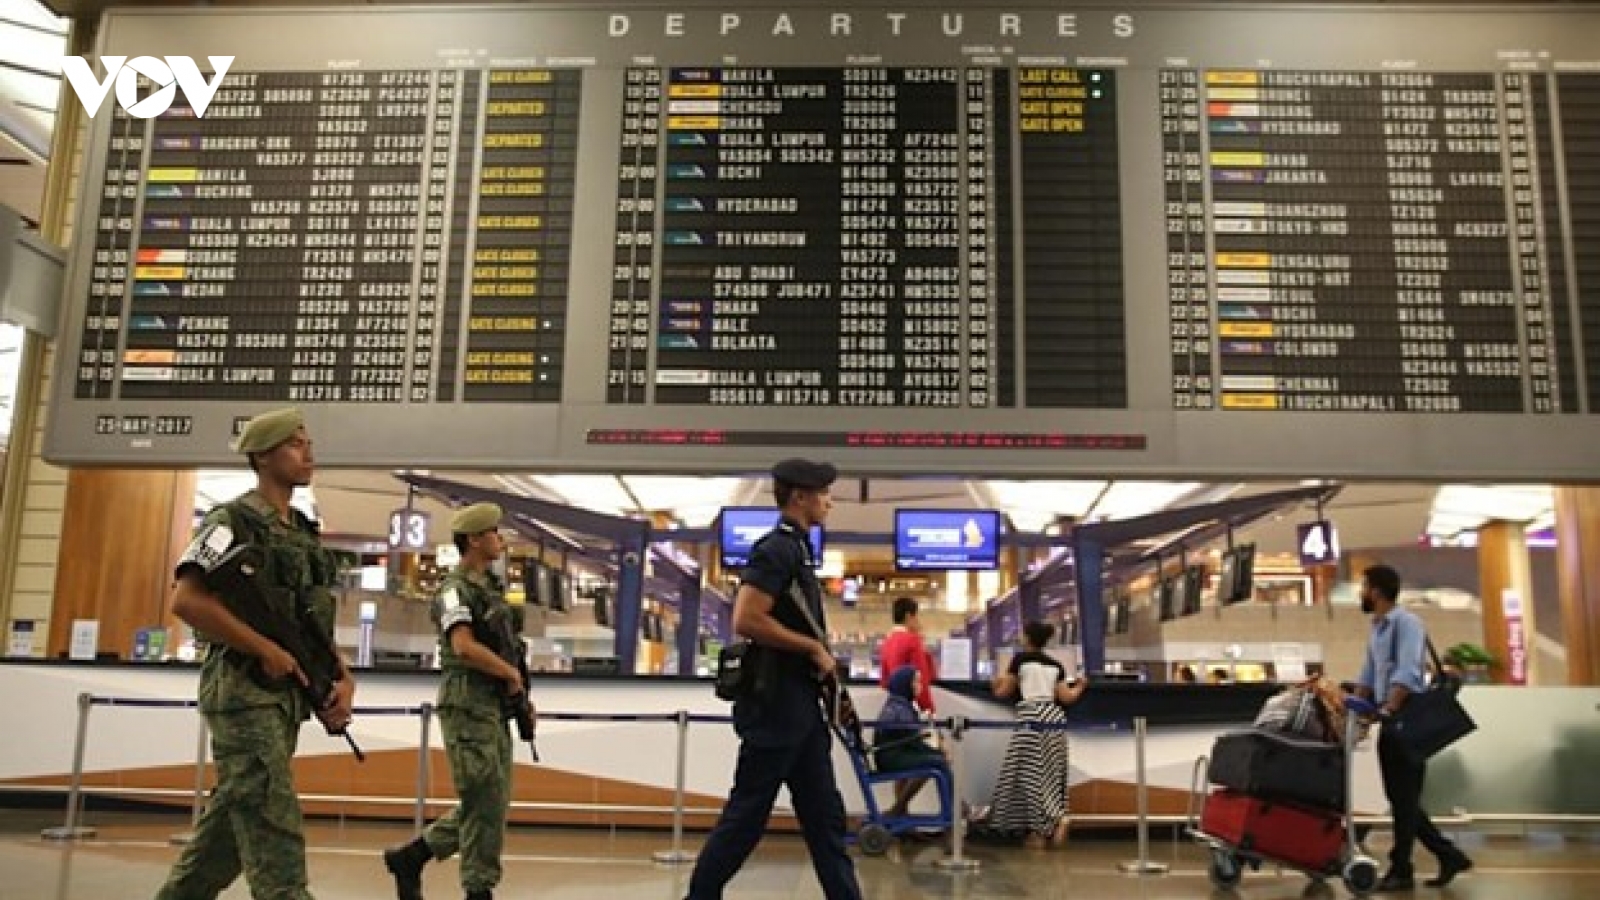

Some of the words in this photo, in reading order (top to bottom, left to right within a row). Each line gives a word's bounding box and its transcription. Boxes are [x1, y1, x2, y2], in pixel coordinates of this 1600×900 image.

[607, 14, 1135, 37] DEPARTURES
[1019, 69, 1047, 82] LAST
[1051, 69, 1079, 82] CALL
[1020, 101, 1048, 114] GATE
[1051, 101, 1083, 114] OPEN
[1020, 117, 1048, 131] GATE
[1051, 117, 1083, 131] OPEN
[772, 133, 826, 145] LUMPUR
[718, 166, 761, 178] KOCHI
[717, 198, 798, 212] HYDERABAD
[717, 232, 806, 246] TRIVANDRUM
[714, 266, 741, 280] ABU
[751, 267, 794, 280] DHABI
[712, 301, 759, 314] DHAKA
[712, 318, 748, 332] MALE
[711, 335, 776, 349] KOLKATA
[766, 371, 821, 385] LUMPUR
[1302, 526, 1328, 559] 4
